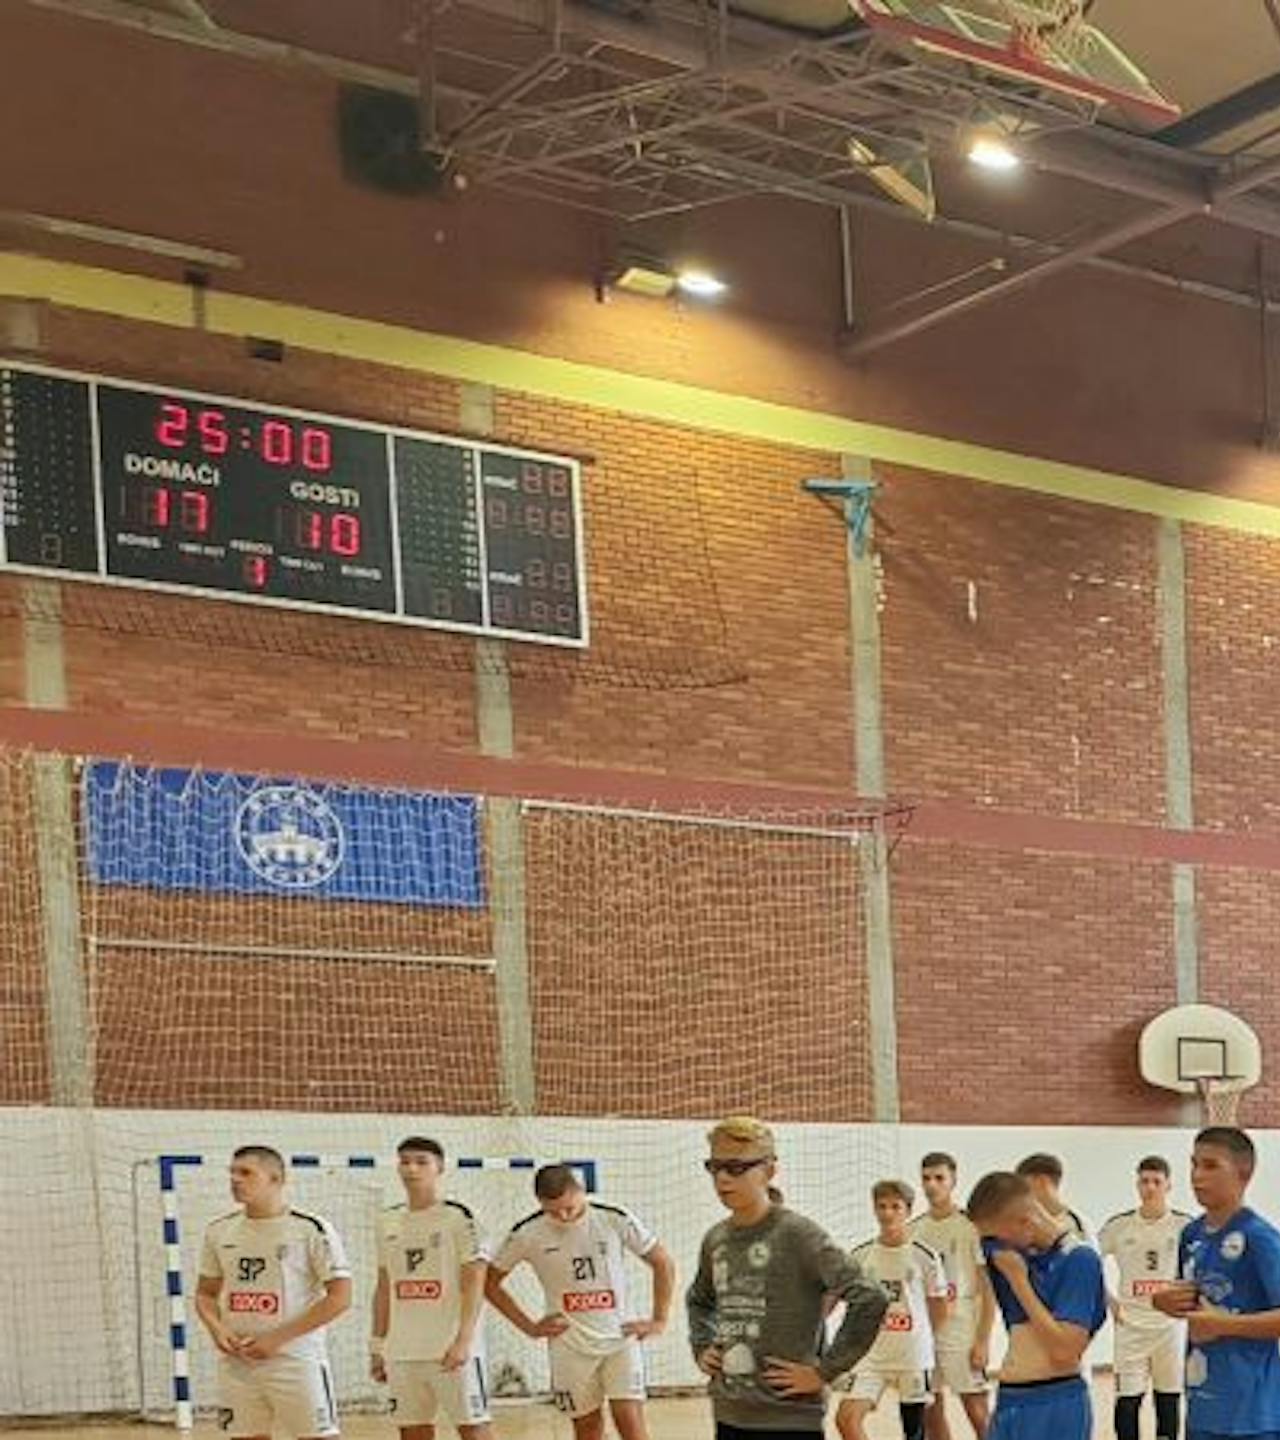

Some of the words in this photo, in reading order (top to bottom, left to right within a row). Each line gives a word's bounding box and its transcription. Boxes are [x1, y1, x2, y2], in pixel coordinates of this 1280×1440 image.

[156, 404, 331, 470] 25:00
[155, 488, 209, 533] 17
[289, 481, 360, 508] GOSTI
[310, 511, 361, 556] 10
[572, 1257, 596, 1281] 21
